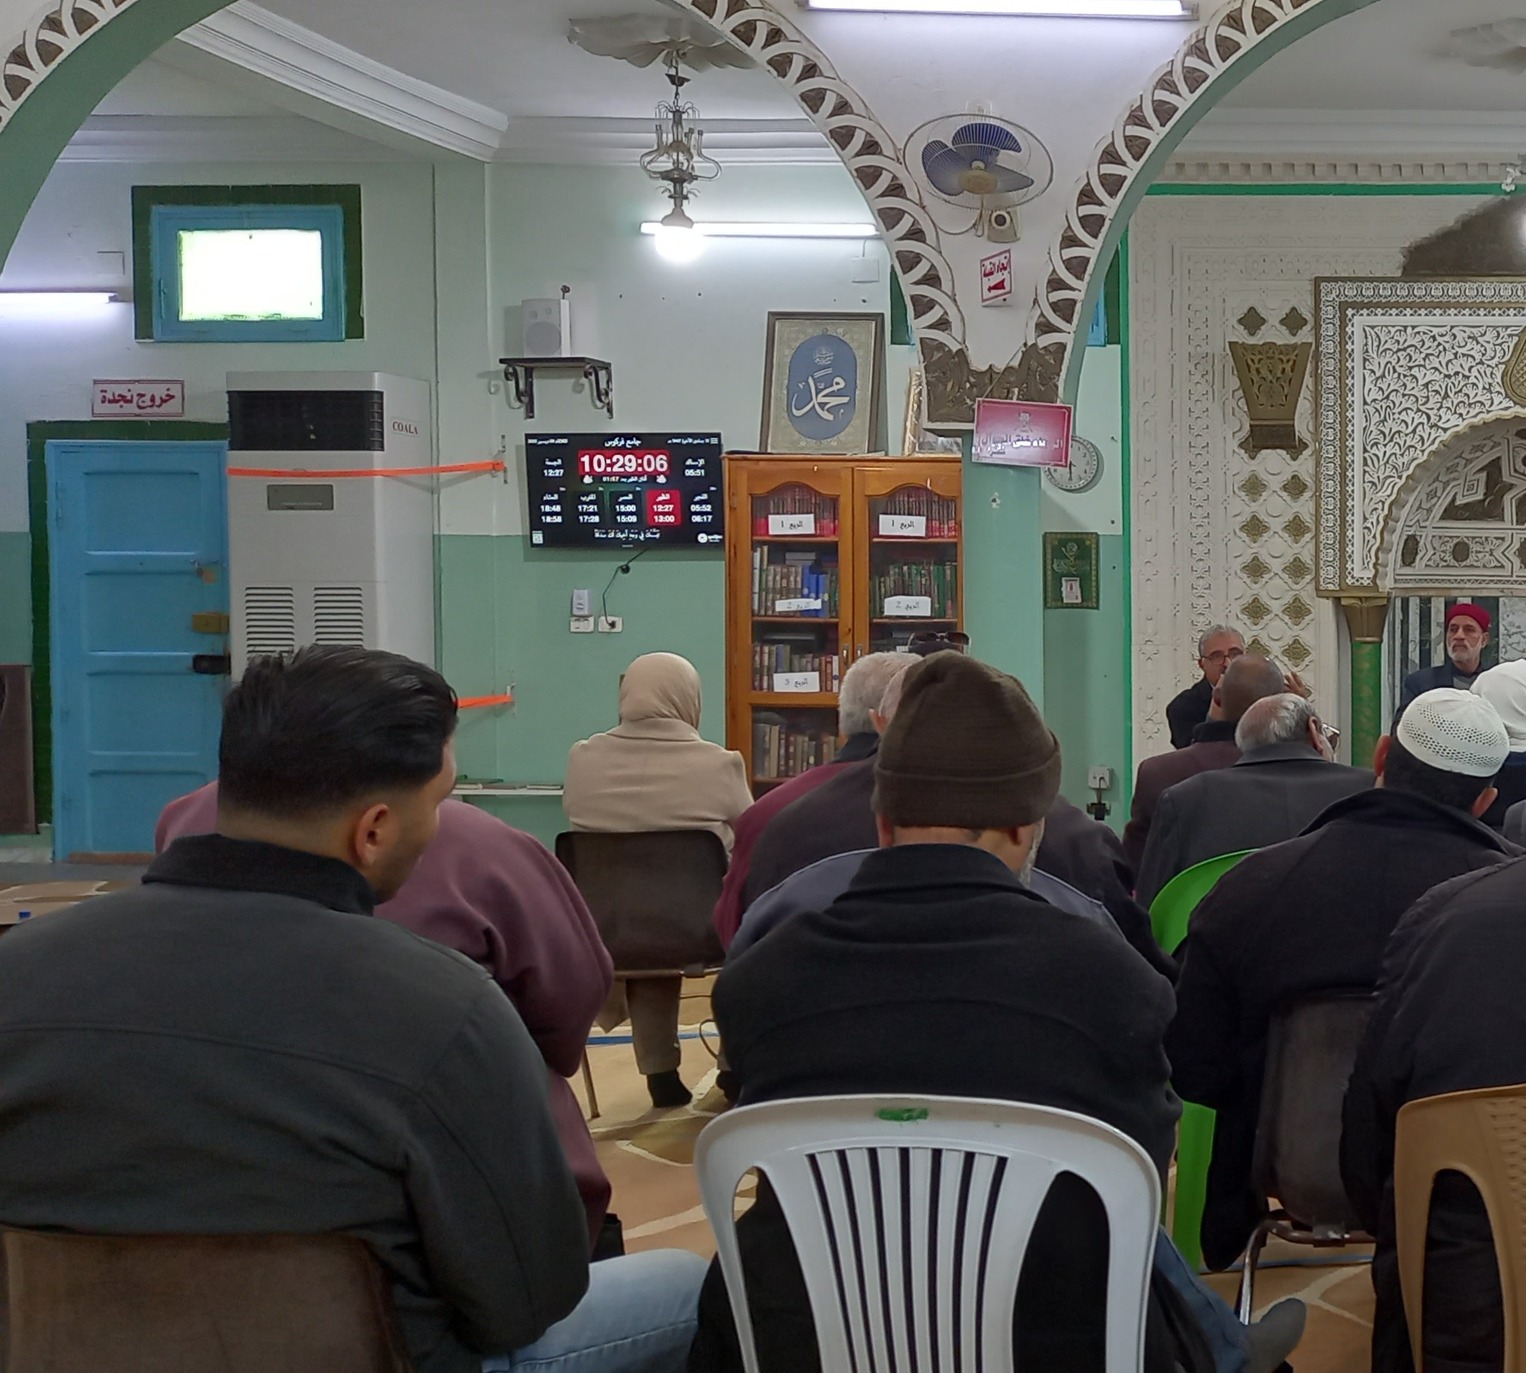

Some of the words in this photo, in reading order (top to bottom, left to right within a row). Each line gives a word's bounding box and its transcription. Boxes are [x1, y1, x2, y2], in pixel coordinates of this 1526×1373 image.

[99, 388, 134, 408] نجدة
[135, 388, 176, 409] خروج
[392, 421, 419, 434] COALA
[580, 454, 668, 473] 10:29:06
[543, 469, 564, 477] 12:27
[578, 504, 598, 512] 17:21
[615, 504, 636, 512] 15:00
[781, 520, 785, 528] 1
[891, 519, 895, 527] 1
